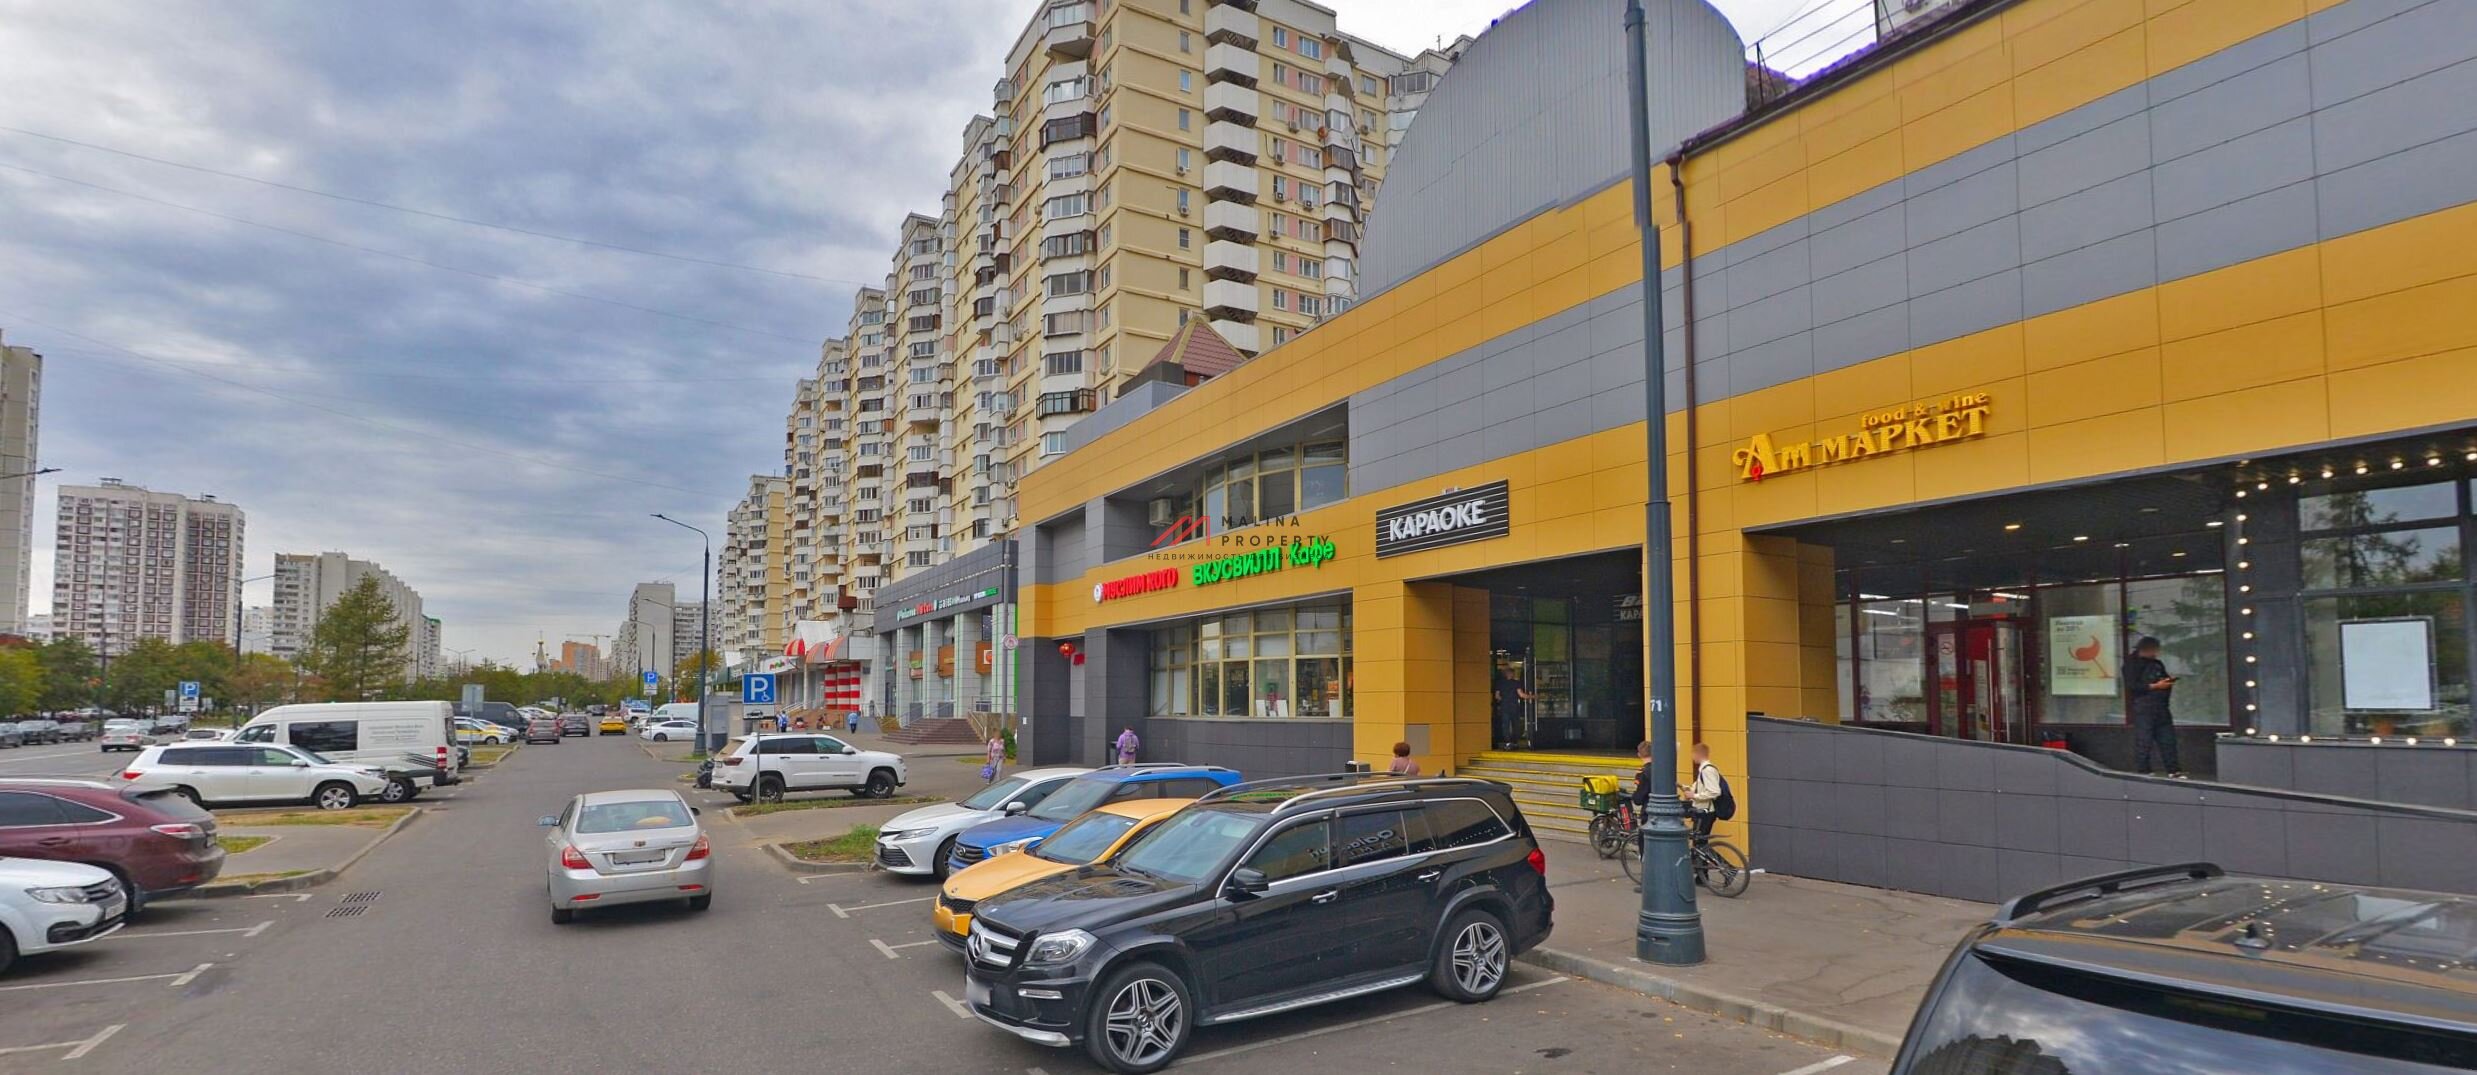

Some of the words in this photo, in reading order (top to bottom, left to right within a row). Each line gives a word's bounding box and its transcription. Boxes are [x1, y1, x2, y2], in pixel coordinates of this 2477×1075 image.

[1820, 404, 1991, 464] МАРКЕТ
[1861, 407, 1906, 429] food
[1913, 402, 1927, 416] &
[1389, 499, 1487, 542] КАРАОКЕ
[1192, 547, 1283, 586] ВКУСВИЛЛ
[1289, 536, 1336, 570] Кафе
[750, 676, 769, 701] P
